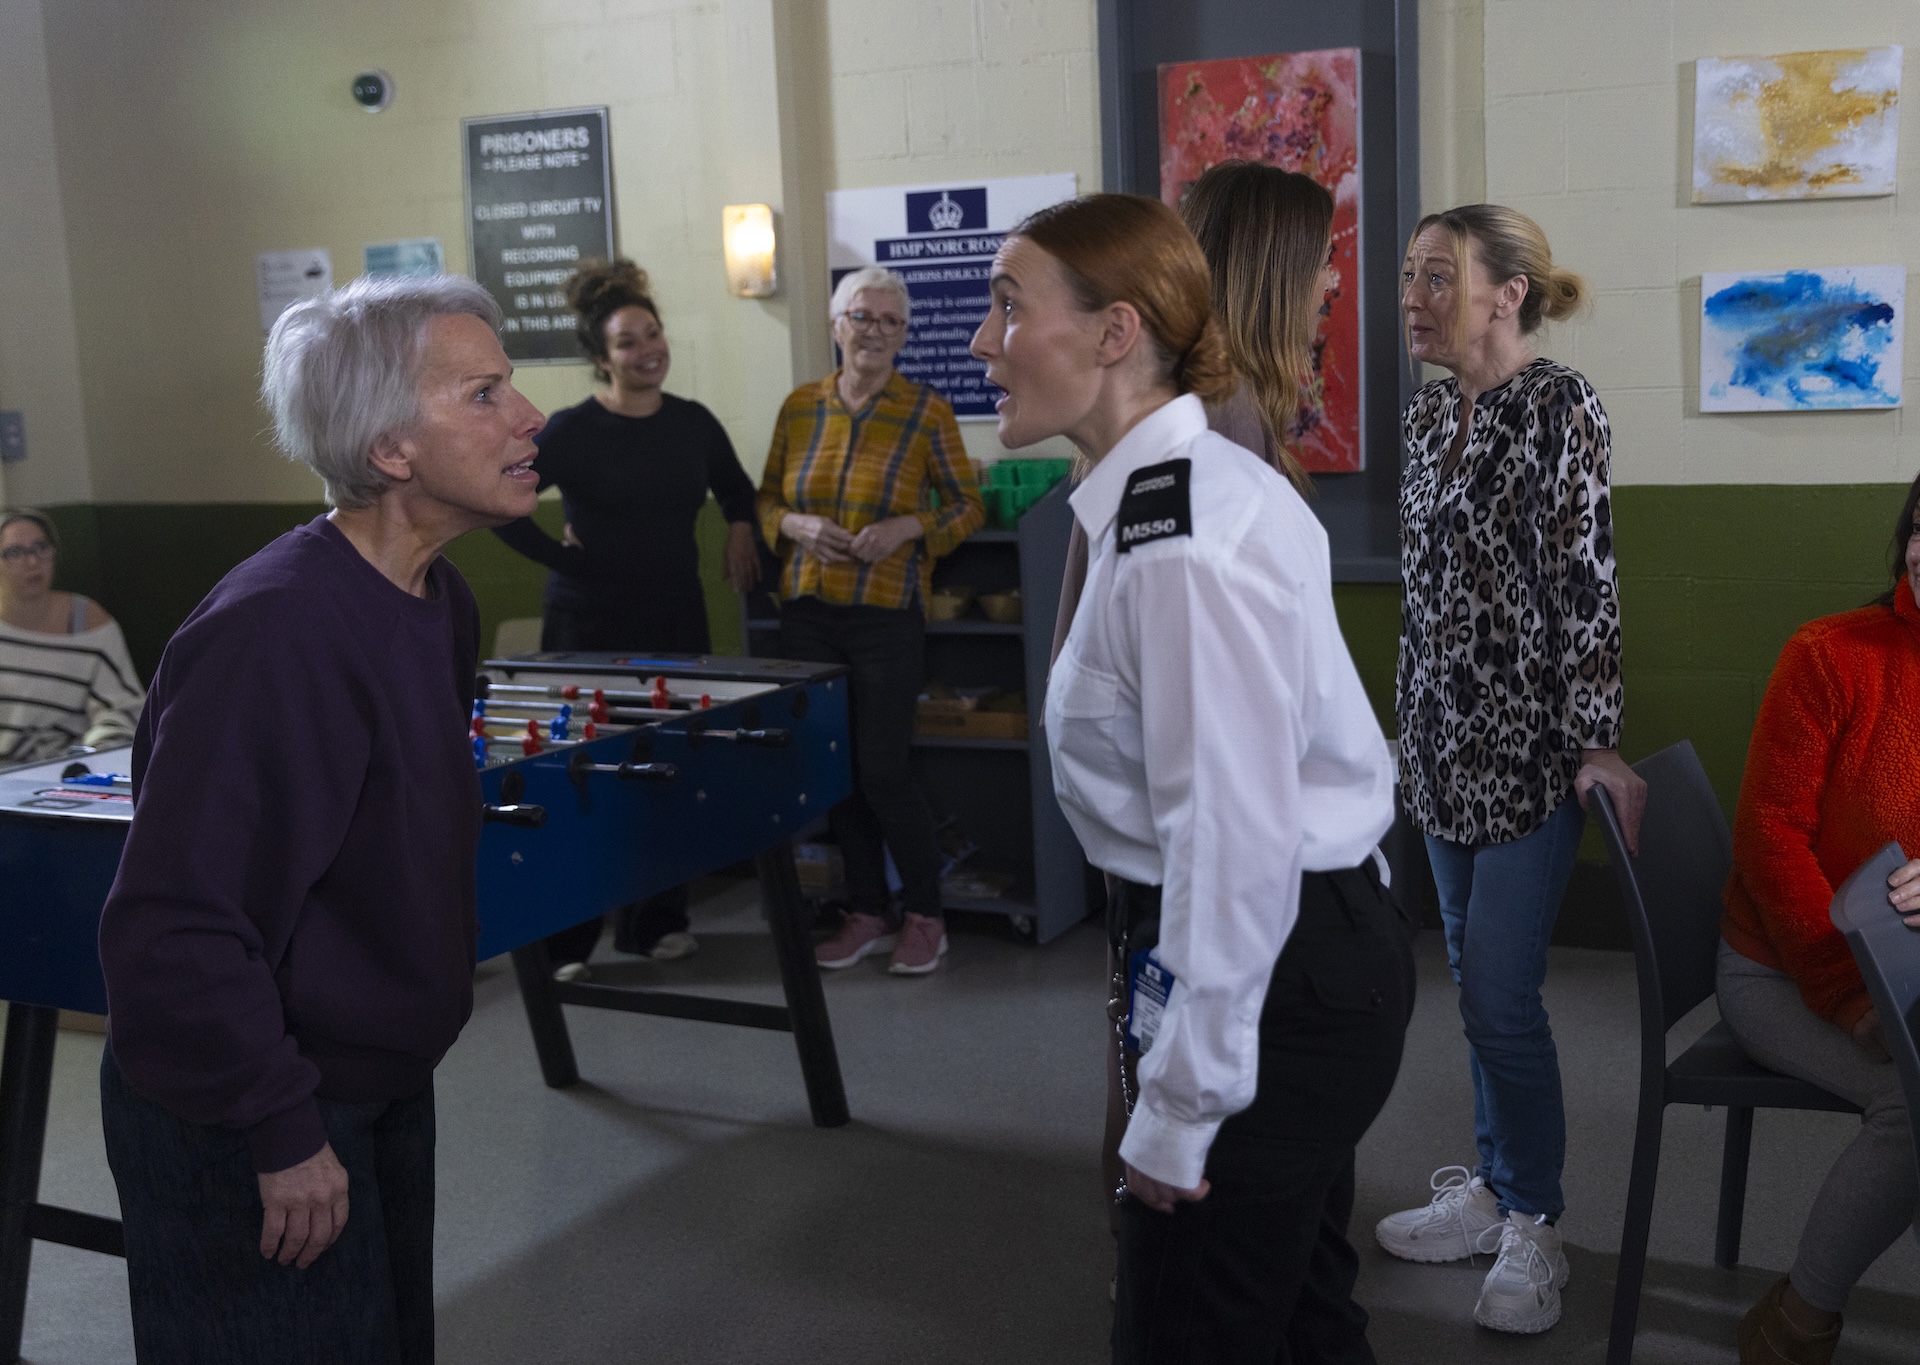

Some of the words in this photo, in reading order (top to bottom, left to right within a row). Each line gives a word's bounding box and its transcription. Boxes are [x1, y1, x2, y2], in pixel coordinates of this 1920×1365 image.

[481, 126, 589, 156] PRISONERS
[492, 154, 541, 172] PLEASE
[543, 151, 579, 168] NOTE
[474, 201, 528, 220] CLOSED
[529, 198, 580, 217] CIRCUIT
[582, 197, 601, 213] TV
[521, 224, 556, 240] WITH
[501, 244, 579, 264] RECORDING
[889, 240, 924, 258] HMP
[943, 266, 983, 280] POLICY
[515, 293, 529, 310] IS
[530, 293, 545, 309] IN
[546, 291, 567, 308] US
[944, 295, 954, 307] is
[505, 318, 520, 332] IN
[520, 315, 550, 331] THIS
[551, 314, 578, 331] ARE
[938, 343, 948, 355] is
[935, 362, 947, 372] or
[949, 375, 961, 387] of
[962, 377, 980, 389] any
[1122, 518, 1177, 542] M550
